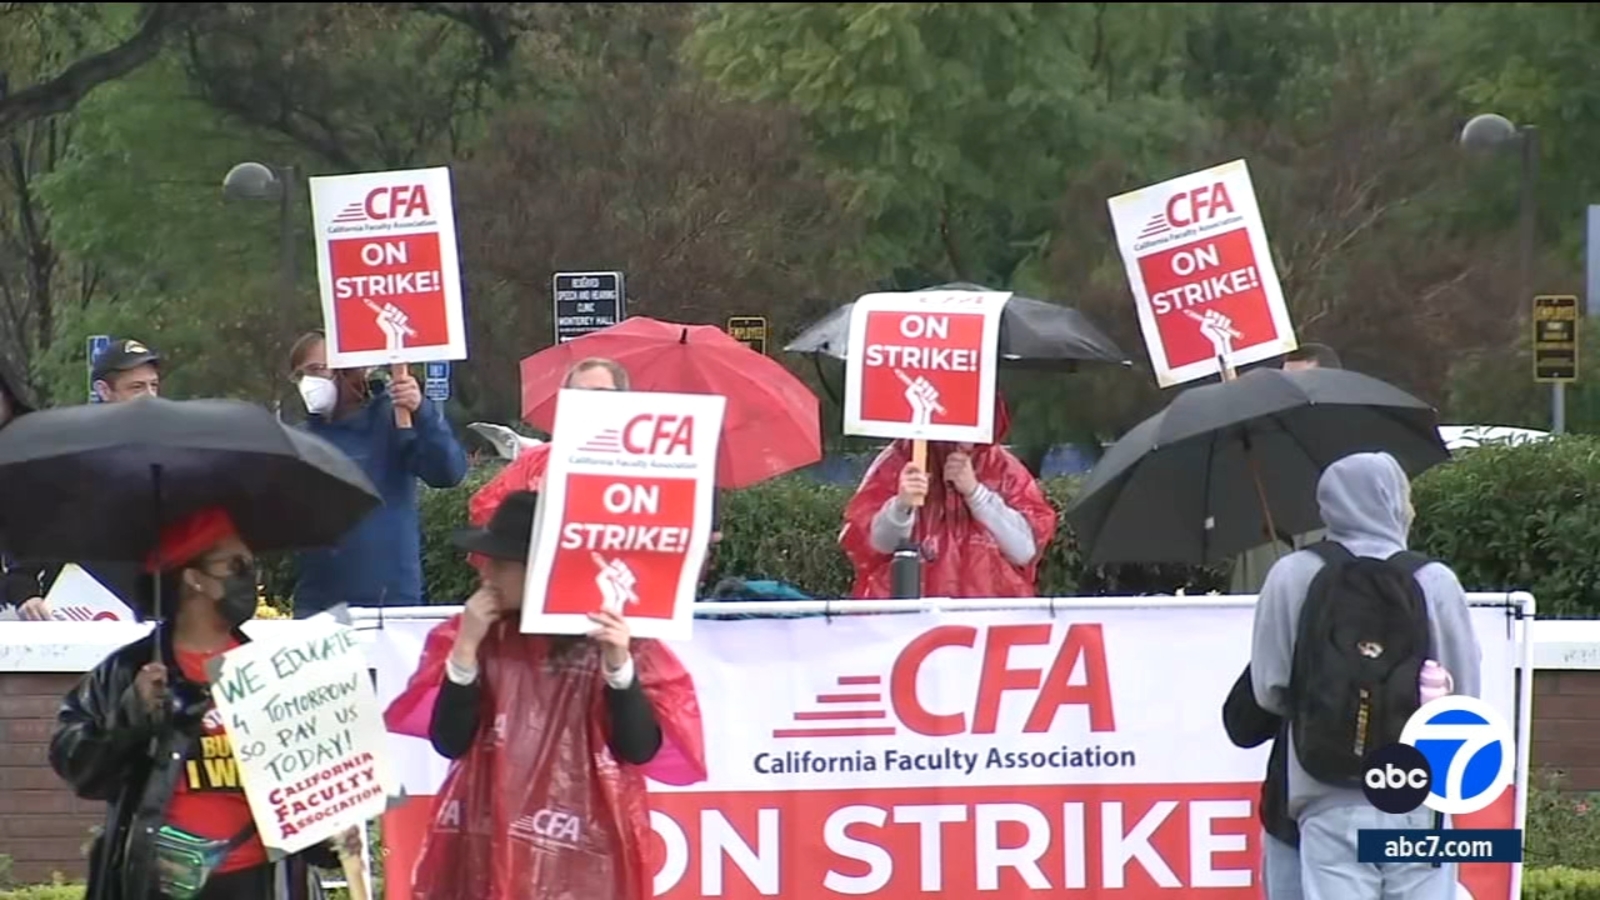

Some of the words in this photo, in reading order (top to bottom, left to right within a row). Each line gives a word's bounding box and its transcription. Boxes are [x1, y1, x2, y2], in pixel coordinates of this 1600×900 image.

[364, 184, 430, 220] CFA
[1166, 182, 1235, 228] CFA
[327, 225, 364, 234] California
[364, 222, 391, 231] Faculty
[393, 219, 437, 228] Association
[1134, 235, 1169, 251] California
[1169, 228, 1196, 243] Faculty
[1199, 215, 1244, 231] Association
[361, 241, 408, 266] ON
[1171, 243, 1220, 276] ON
[335, 270, 441, 299] STRIKE!
[1152, 266, 1259, 314] STRIKE!
[900, 314, 949, 339] ON
[866, 344, 977, 372] STRIKE!
[622, 413, 694, 455] CFA
[568, 456, 614, 466] California
[616, 459, 647, 469] Faculty
[650, 460, 698, 469] Association
[603, 482, 659, 514] ON
[560, 521, 690, 553] STRIKE!
[219, 661, 265, 704] WE
[890, 623, 1116, 737] CFA
[233, 714, 249, 734] 4
[262, 673, 358, 724] TOMORROW
[277, 715, 318, 748] PAY
[334, 704, 359, 725] US
[264, 730, 354, 782] TODAY!
[753, 751, 877, 774] California
[884, 748, 978, 775] Faculty
[985, 745, 1136, 769] Association
[274, 767, 375, 823] FACULTY
[532, 809, 580, 842] CFA
[822, 800, 1253, 896] STRIKE
